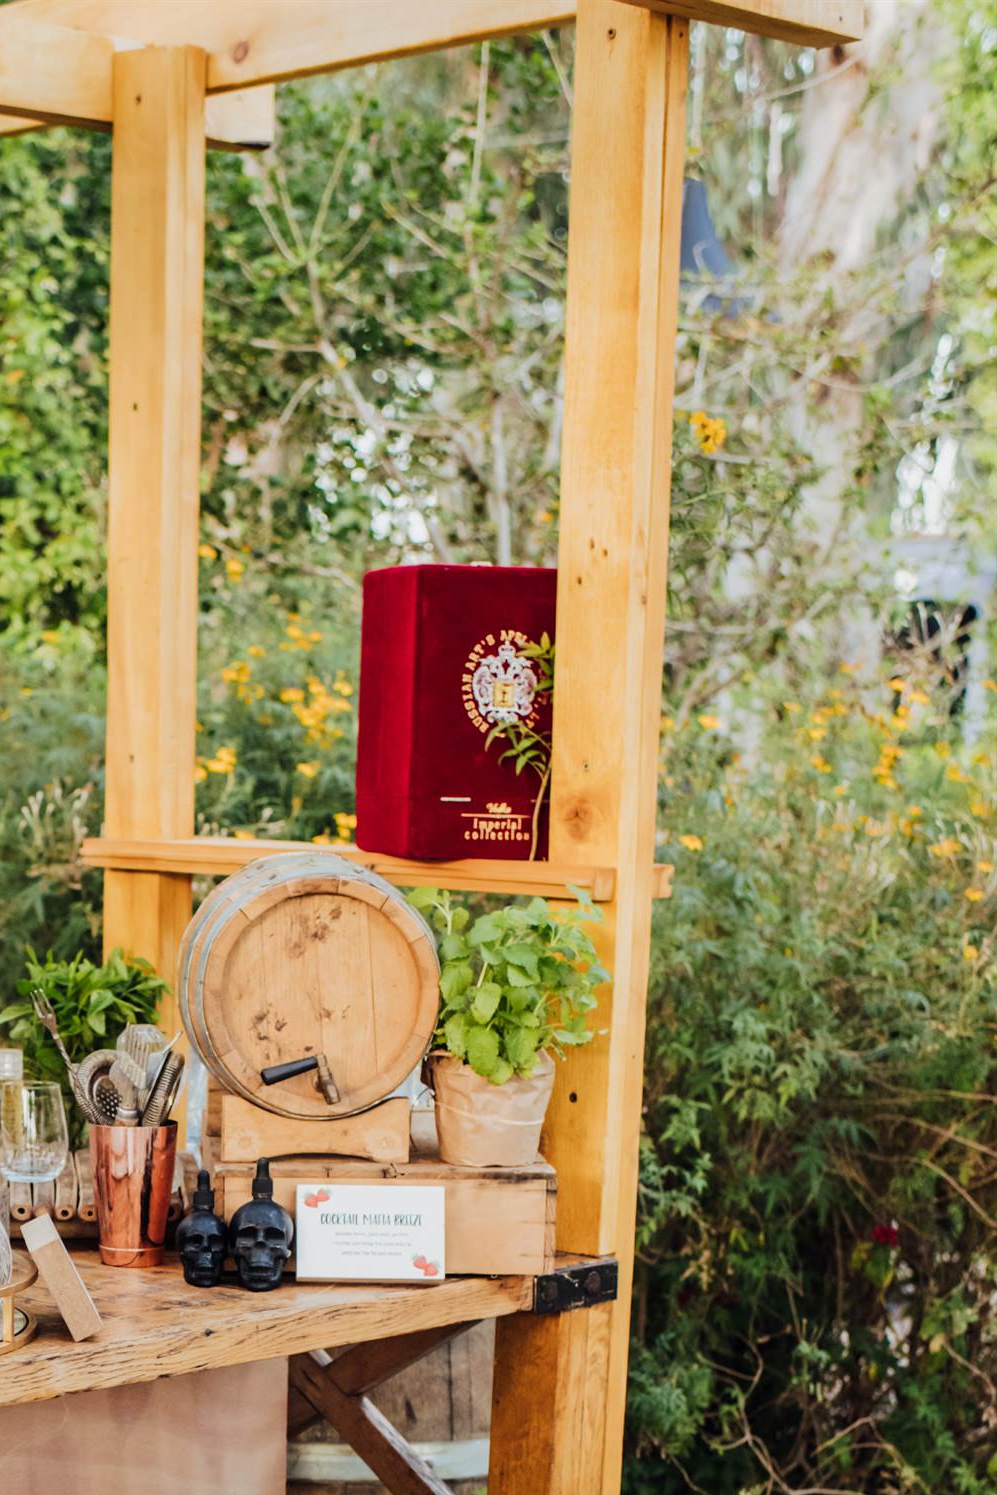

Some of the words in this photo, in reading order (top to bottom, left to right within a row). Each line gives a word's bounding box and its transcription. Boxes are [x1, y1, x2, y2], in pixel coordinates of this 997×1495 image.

[473, 817, 522, 832] Imperial
[464, 830, 530, 840] collection
[320, 1212, 359, 1225] COCKTAIL
